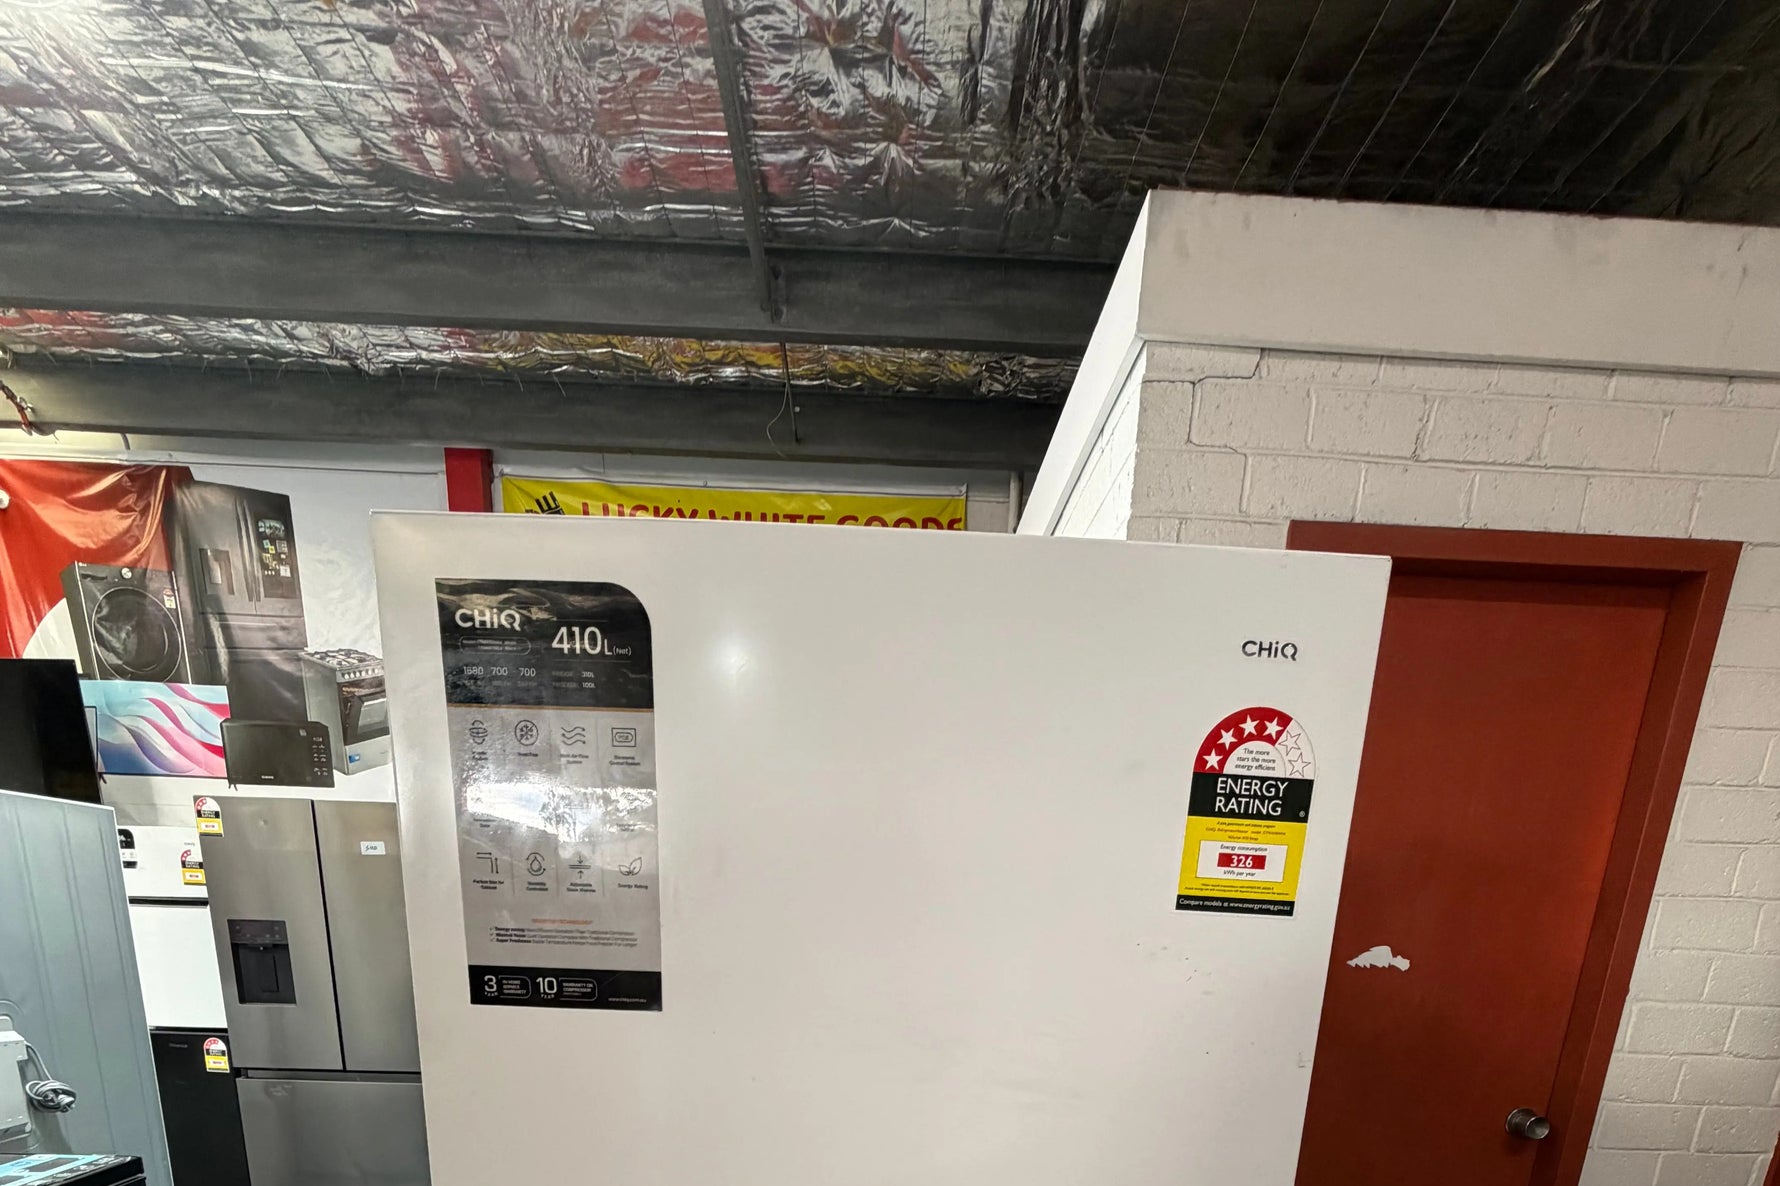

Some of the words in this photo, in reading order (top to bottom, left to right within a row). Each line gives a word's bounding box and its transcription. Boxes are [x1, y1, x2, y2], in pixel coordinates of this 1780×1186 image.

[454, 607, 522, 632] CHiQ
[1241, 639, 1298, 662] CHiQ
[490, 666, 509, 676] 700
[518, 667, 537, 677] 700
[1242, 747, 1254, 755] The
[1235, 763, 1254, 771] energy
[1216, 777, 1289, 798] ENERGY
[1214, 796, 1283, 816] RATING
[1230, 855, 1253, 868] 326
[1179, 898, 1203, 907] Compare
[1204, 899, 1222, 907] models
[484, 974, 498, 993] 3
[535, 976, 558, 994] 10
